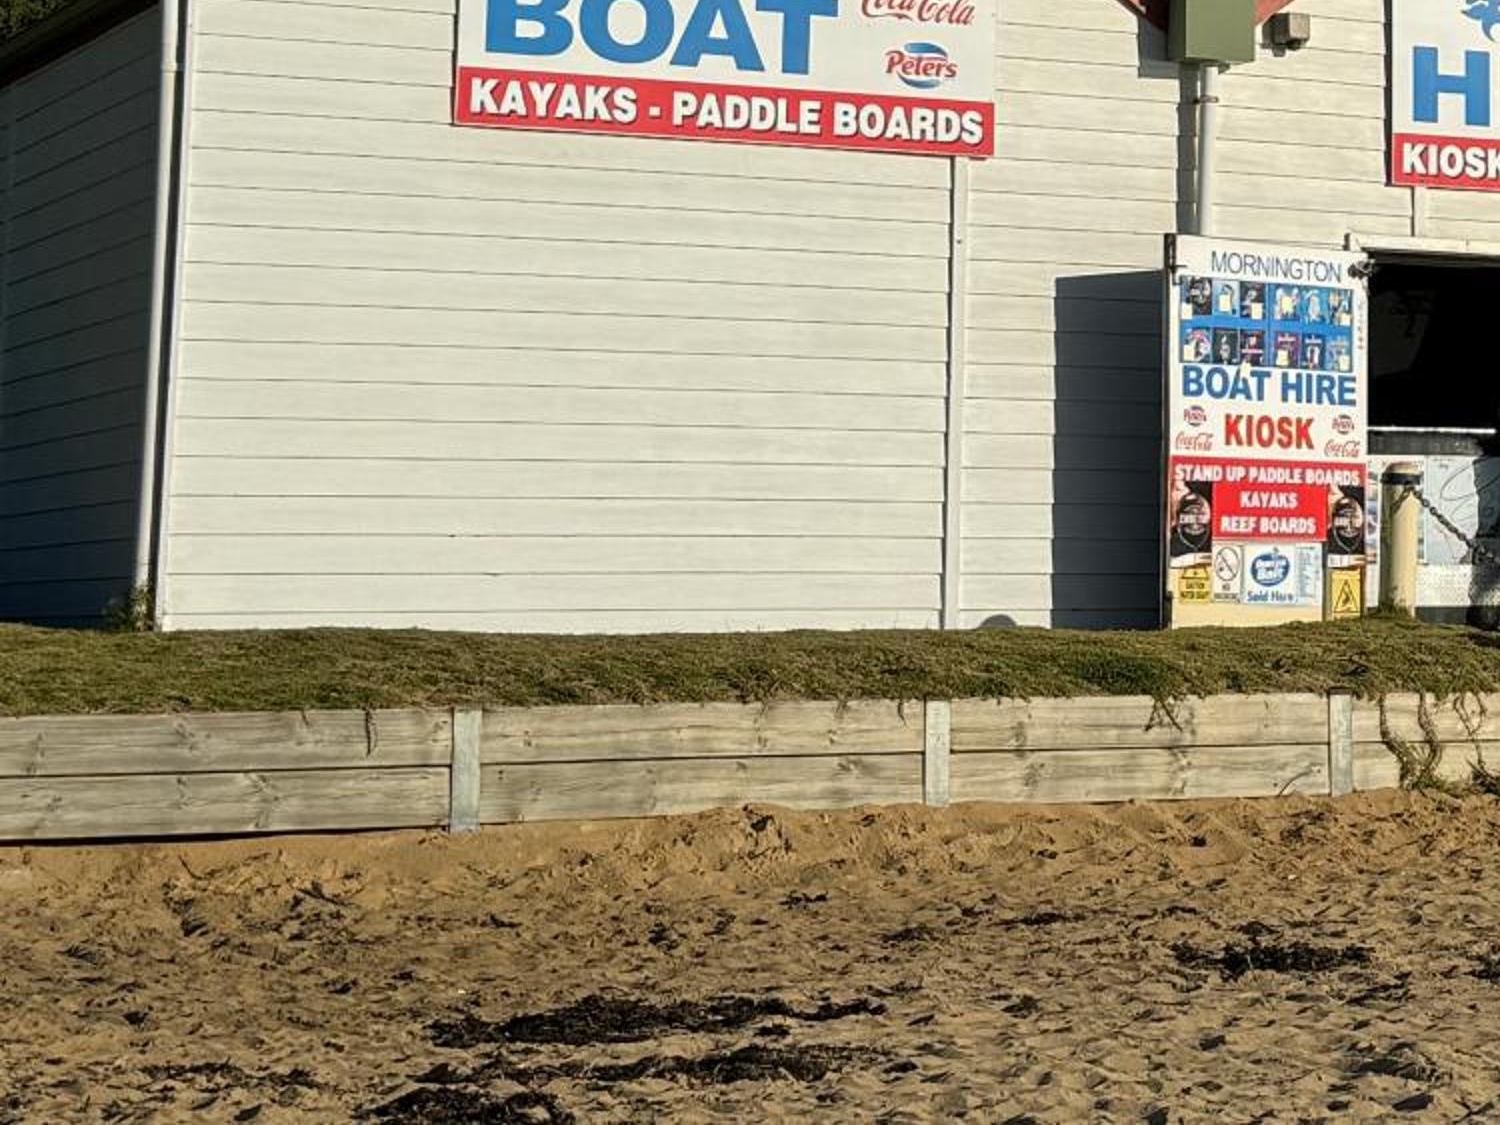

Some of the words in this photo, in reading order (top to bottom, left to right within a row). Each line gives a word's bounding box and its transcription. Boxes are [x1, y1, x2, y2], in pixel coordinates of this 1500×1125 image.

[884, 50, 958, 79] Peters
[470, 77, 637, 123] KAYAKS
[672, 91, 821, 134] PADDLE
[833, 102, 983, 144] BOARDS
[1211, 251, 1342, 283] MORNINGTON
[1182, 365, 1271, 401] BOAT
[1281, 372, 1357, 406] HIRE
[1224, 413, 1314, 450] KIOSK
[1174, 463, 1223, 482] STAND
[1225, 466, 1247, 482] UP
[1248, 467, 1303, 484] PADDLE
[1305, 468, 1361, 487] BOARDS
[1240, 490, 1298, 509] KAYAKS
[1221, 516, 1257, 533] REEF
[1259, 516, 1316, 534] BOARDS
